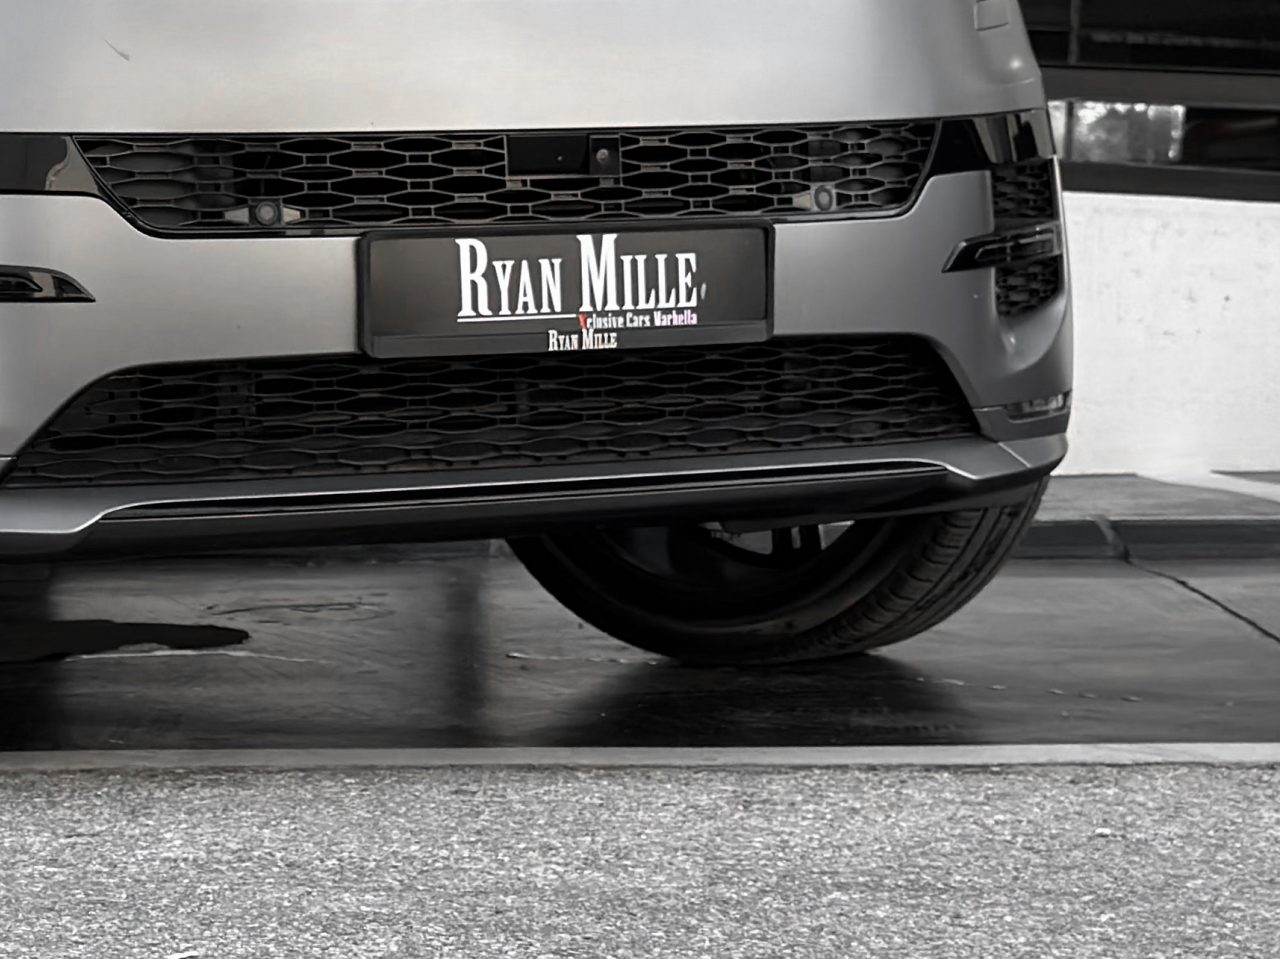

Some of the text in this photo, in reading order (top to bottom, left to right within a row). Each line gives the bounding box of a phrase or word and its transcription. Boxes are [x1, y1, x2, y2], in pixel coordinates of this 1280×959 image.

[454, 232, 699, 318] RYAN MILLE
[625, 311, 652, 328] Cars
[548, 327, 618, 352] RYAN MILLE
